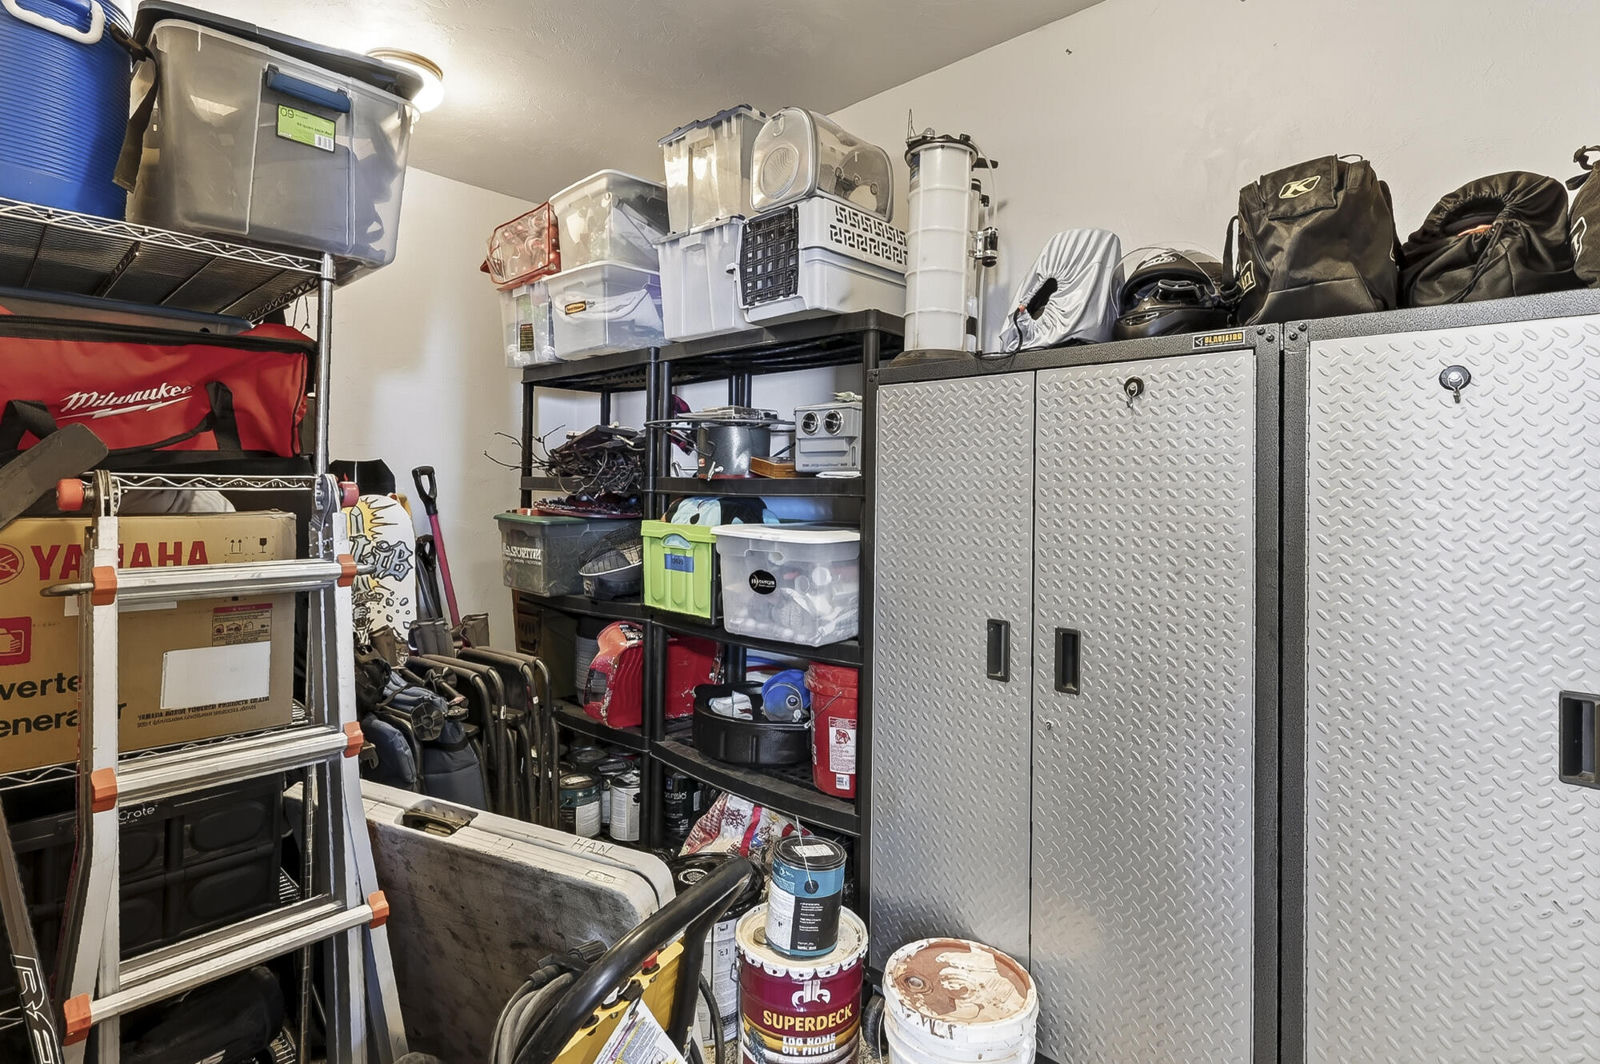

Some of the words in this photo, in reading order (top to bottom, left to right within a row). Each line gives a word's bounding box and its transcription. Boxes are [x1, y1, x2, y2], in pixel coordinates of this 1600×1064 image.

[60, 382, 192, 412] Milwaukee
[31, 540, 209, 581] YAAHA
[0, 672, 79, 701] verte
[763, 1003, 853, 1032] SUPERDECK
